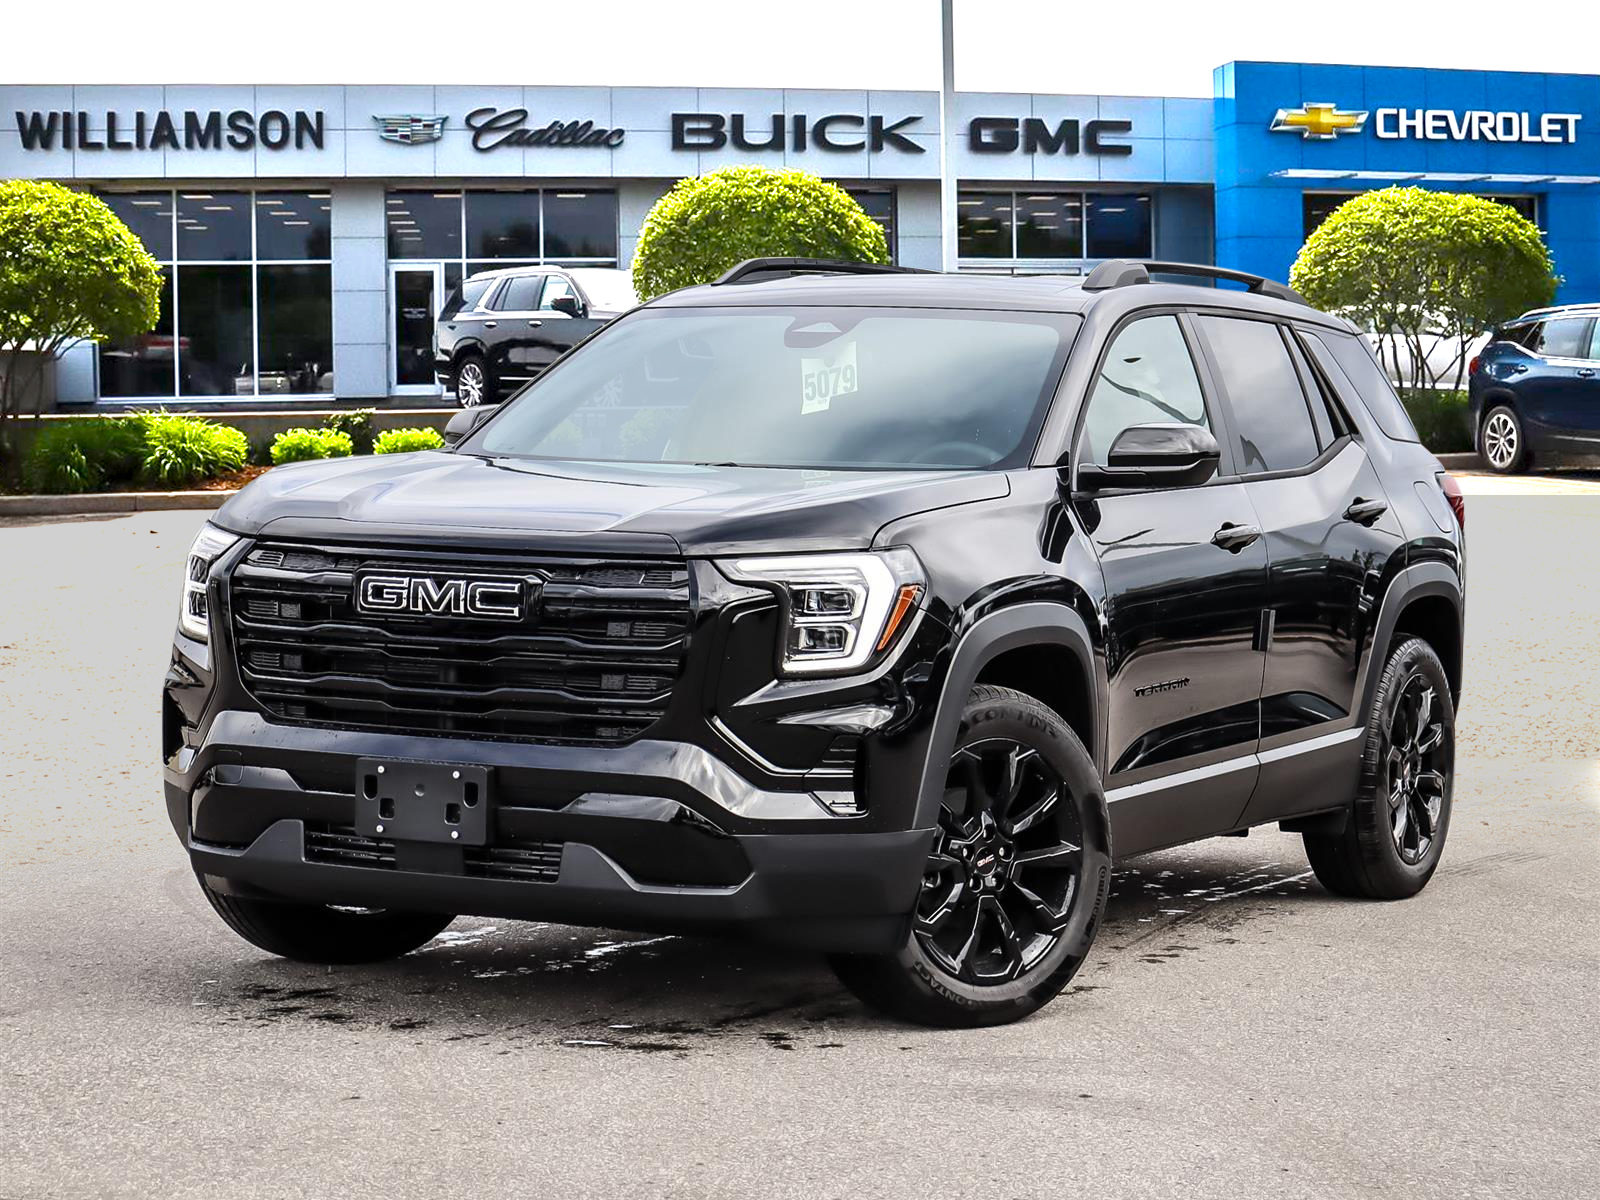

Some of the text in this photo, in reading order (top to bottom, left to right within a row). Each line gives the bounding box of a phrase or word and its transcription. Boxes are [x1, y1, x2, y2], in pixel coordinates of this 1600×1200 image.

[15, 110, 324, 150] WILLIAMSON
[464, 107, 625, 151] Cadillac
[671, 113, 926, 152] BUICK
[970, 117, 1133, 155] GMC
[1375, 108, 1582, 143] CHEVROLET
[804, 364, 856, 402] 5079
[360, 576, 521, 617] GMC
